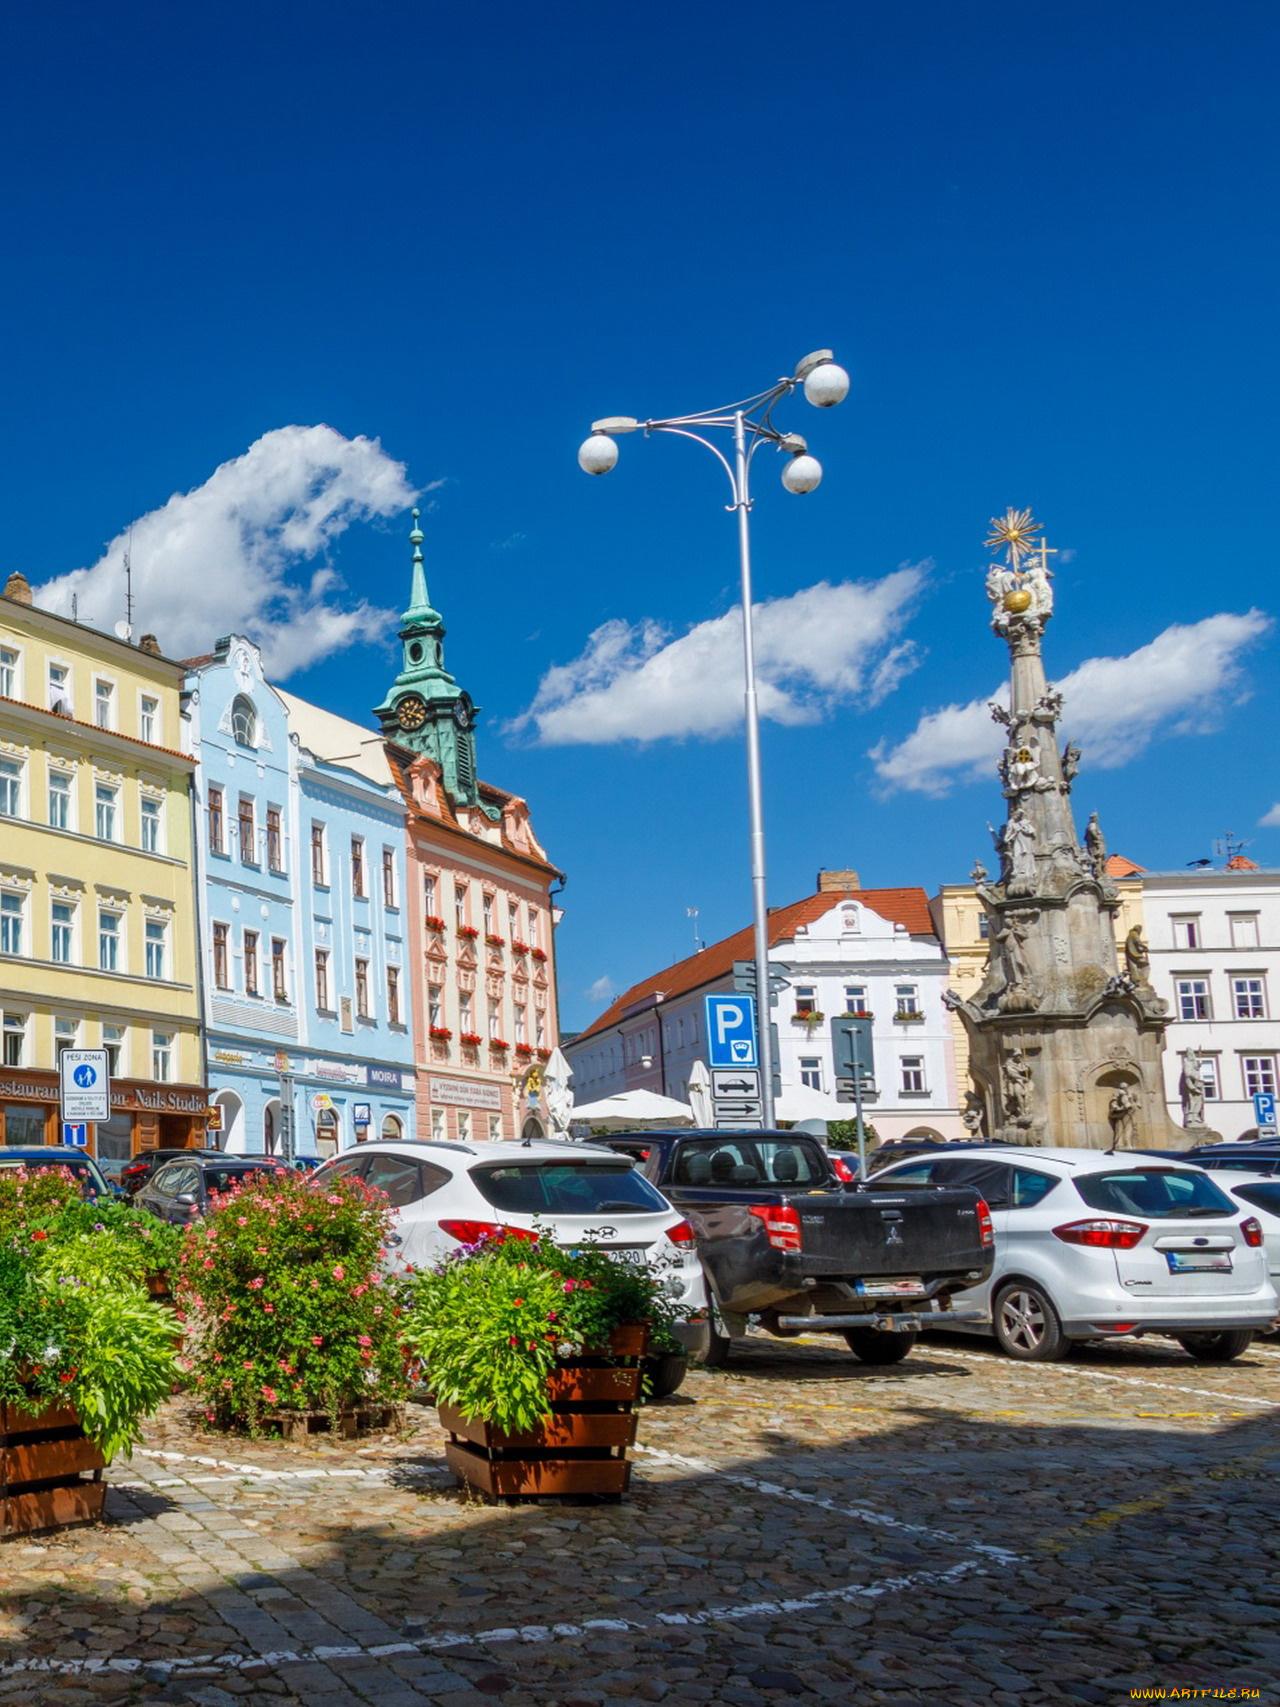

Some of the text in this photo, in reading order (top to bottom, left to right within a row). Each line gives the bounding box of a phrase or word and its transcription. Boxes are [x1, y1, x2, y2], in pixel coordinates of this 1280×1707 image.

[716, 1004, 744, 1044] P
[371, 1069, 398, 1084] MOIRA
[135, 1088, 166, 1110] Nails
[167, 1091, 206, 1113] Studio
[1258, 1097, 1271, 1115] P
